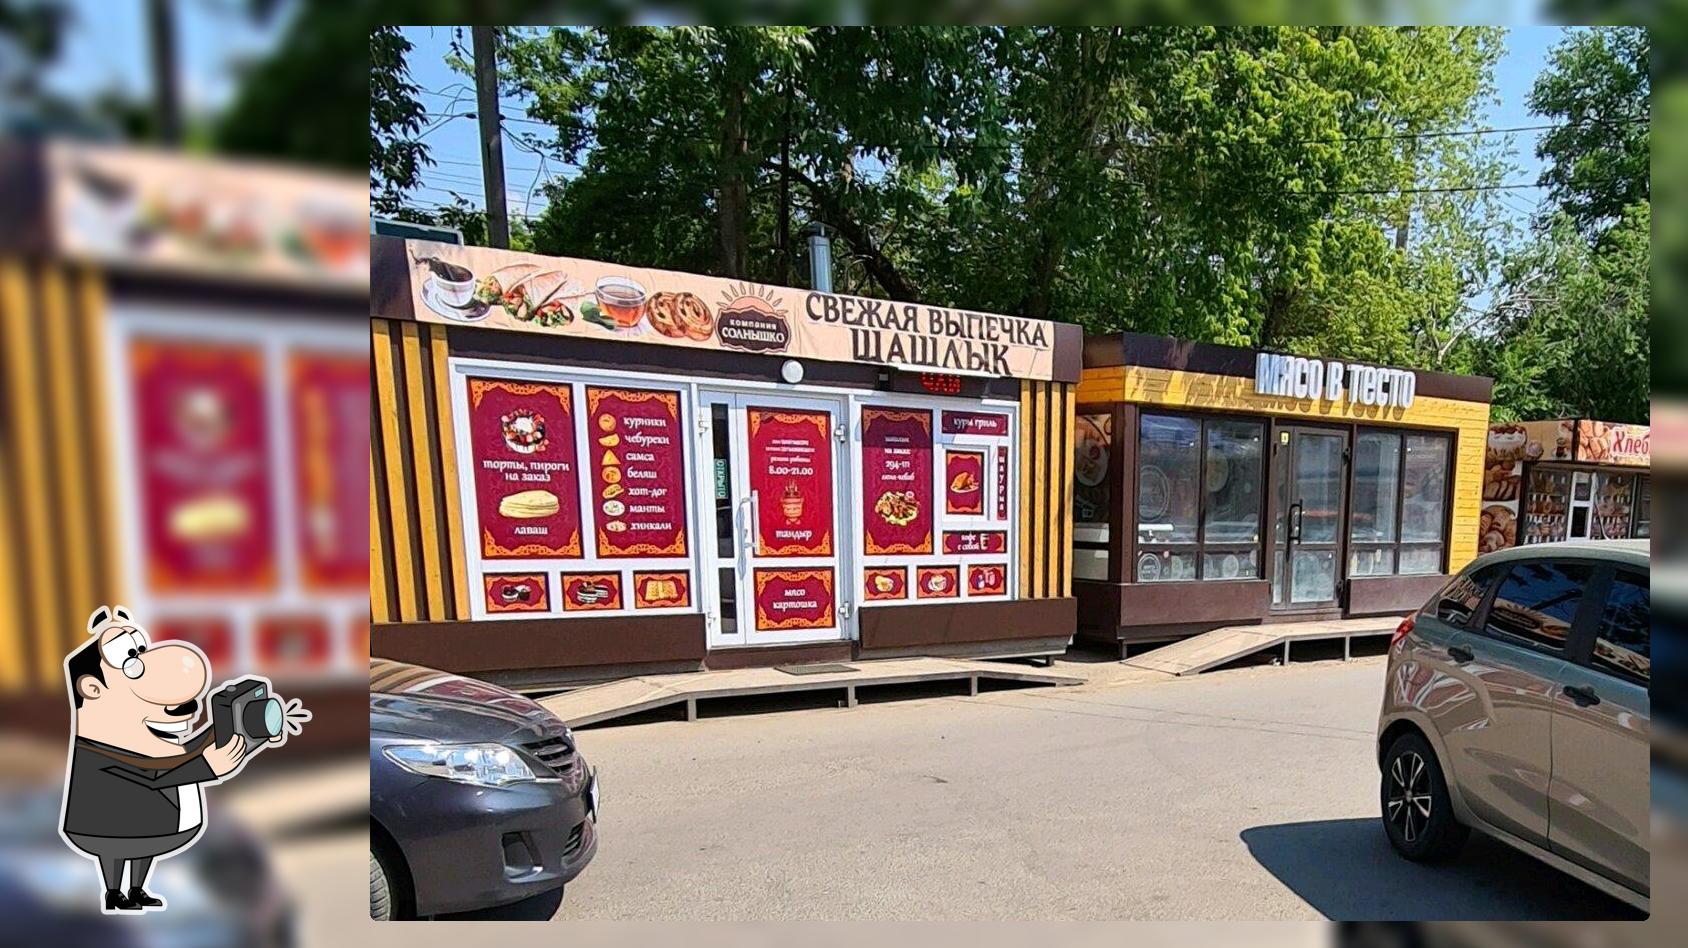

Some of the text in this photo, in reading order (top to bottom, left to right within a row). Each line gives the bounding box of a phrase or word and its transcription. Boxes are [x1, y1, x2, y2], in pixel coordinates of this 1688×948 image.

[806, 292, 1049, 348] СВЕЖАЯ ВЫПЕЧКА
[721, 326, 785, 343] СОЛНЫШКО
[850, 327, 1013, 377] ШАШЛЫК
[623, 417, 667, 429] курники
[624, 431, 670, 447] чебуреки
[1613, 430, 1650, 455] Хлеб
[625, 452, 655, 461] самса
[483, 460, 570, 474] торты, пироги
[627, 466, 657, 479] беляш
[768, 465, 814, 475] 8.00-21.00
[505, 472, 551, 482] на заказ
[628, 487, 667, 498] хот-дог
[629, 504, 665, 513] манты
[514, 526, 548, 535] лаваш
[630, 522, 672, 531] хинкали
[773, 600, 818, 612] картошка
